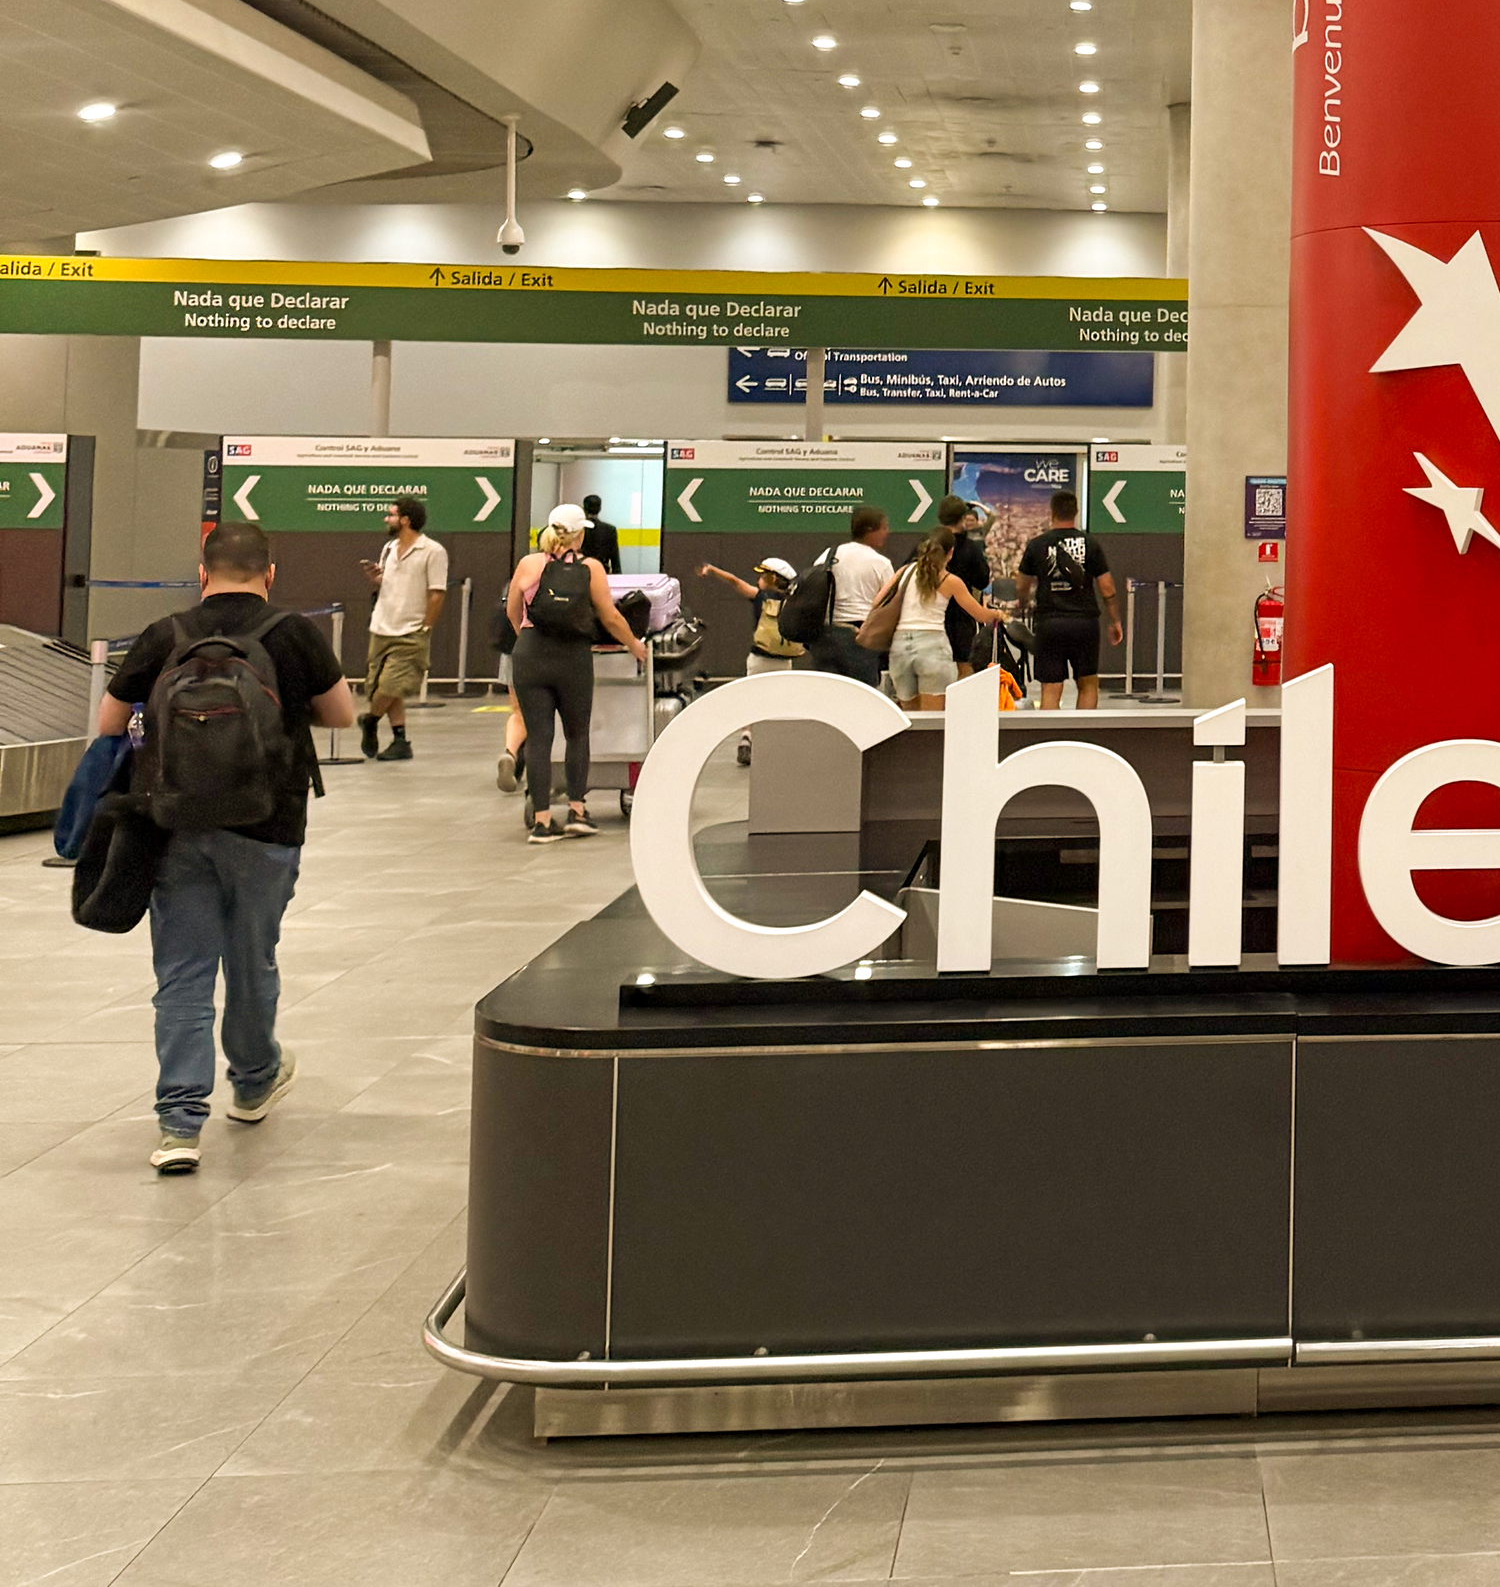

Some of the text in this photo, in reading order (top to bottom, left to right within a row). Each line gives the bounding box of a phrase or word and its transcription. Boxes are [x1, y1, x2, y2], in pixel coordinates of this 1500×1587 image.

[47, 262, 56, 277] /
[60, 262, 94, 278] Exit
[451, 270, 554, 288] Salida / Exit
[898, 279, 996, 295] Salida / Exit
[173, 290, 350, 312] Nada que Declarar
[632, 300, 802, 320] Nada que Declarar
[1069, 306, 1114, 322] Nada
[1118, 310, 1152, 326] que
[184, 313, 337, 331] Nothing to declare
[643, 321, 790, 340] Nothing to declare
[1079, 327, 1140, 345] Nothing
[1144, 329, 1160, 342] to
[833, 351, 908, 363] Transportation
[860, 373, 1066, 387] Bus, Minibús, Taxi, Arriendo de Autos
[860, 388, 999, 399] Bus, Transfer, Taxi, Rent-a-Car
[228, 445, 251, 455] SAG
[671, 449, 694, 460] SAG
[1097, 452, 1117, 462] SAG
[1024, 468, 1069, 482] CARE
[308, 484, 428, 496] NADA QUE DECLARAR
[749, 487, 864, 497] NADA QUE DECLARAR
[317, 503, 375, 512] NOTHING TO
[758, 505, 854, 514] NOTHING TO DECLARE
